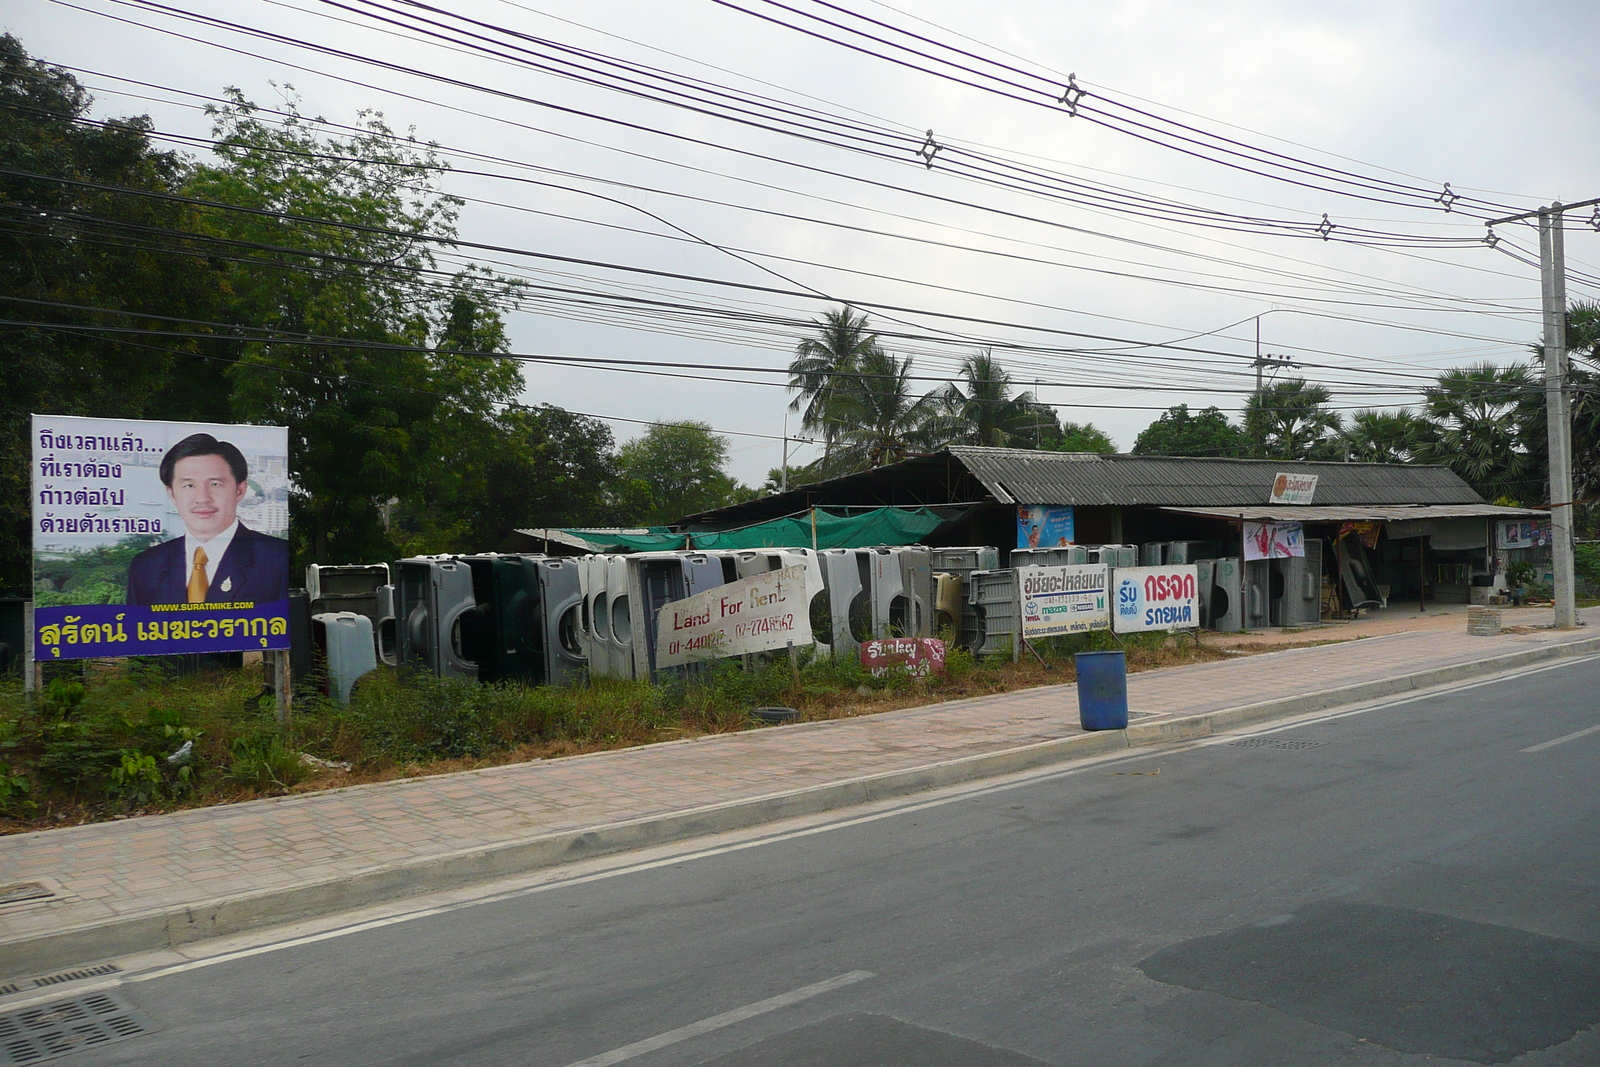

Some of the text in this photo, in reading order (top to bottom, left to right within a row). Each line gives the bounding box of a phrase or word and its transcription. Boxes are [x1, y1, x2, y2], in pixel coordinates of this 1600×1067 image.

[39, 428, 164, 453] ถึงเวลาแล้ว...
[39, 453, 122, 479] ที่เราต้อง
[39, 483, 125, 506] ก้าวต่อไป
[39, 511, 162, 533] ด้วยตัวเราเอง
[1119, 580, 1138, 603] รับ
[1144, 573, 1195, 602] กระจก
[150, 601, 255, 613] WWW.SURATMIKE.COM
[673, 601, 711, 631] Land
[720, 596, 744, 618] For
[1145, 598, 1192, 626] รถยนต์
[39, 613, 288, 658] สุรัตน์ เมฆะวรากุล
